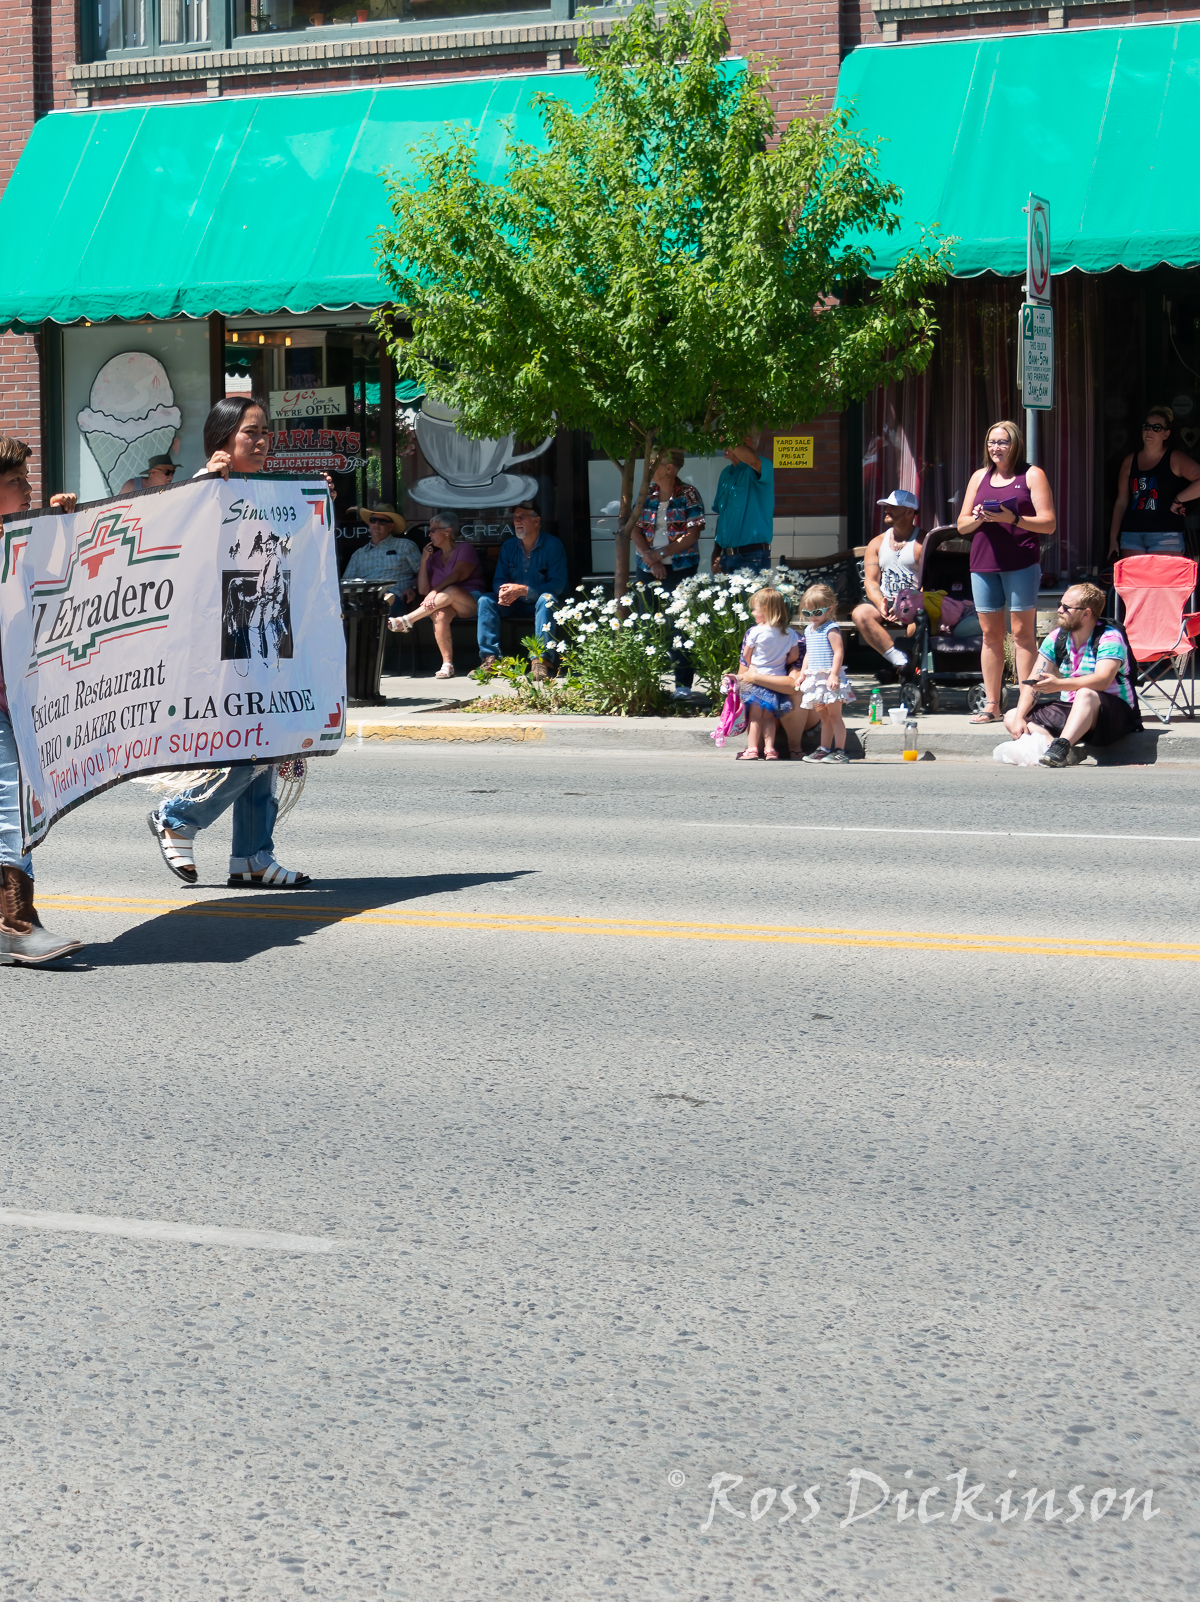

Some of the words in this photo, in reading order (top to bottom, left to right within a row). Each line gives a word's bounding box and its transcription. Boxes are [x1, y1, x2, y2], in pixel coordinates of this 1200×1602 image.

[1024, 307, 1032, 337] 2
[1034, 325, 1051, 338] PARKING
[1029, 341, 1037, 350] THIS
[1037, 341, 1047, 351] BLOCK
[1027, 372, 1033, 381] NO
[1034, 372, 1049, 382] PARKING
[275, 409, 302, 418] WERE
[305, 404, 341, 416] OPEN
[266, 458, 341, 468] DELICATESSEN
[270, 506, 297, 522] 1993
[335, 526, 372, 539] OUP
[460, 524, 514, 539] CREA
[31, 603, 47, 657] l
[45, 576, 174, 645] Erradero
[74, 659, 166, 712] Restaurant
[38, 734, 62, 771] ARIO
[73, 710, 117, 750] BAKER
[120, 700, 162, 731] CITY
[183, 695, 218, 720] LA
[223, 689, 316, 718] GRANDE
[81, 752, 105, 788] you
[124, 735, 163, 769] your
[168, 721, 270, 758] support.
